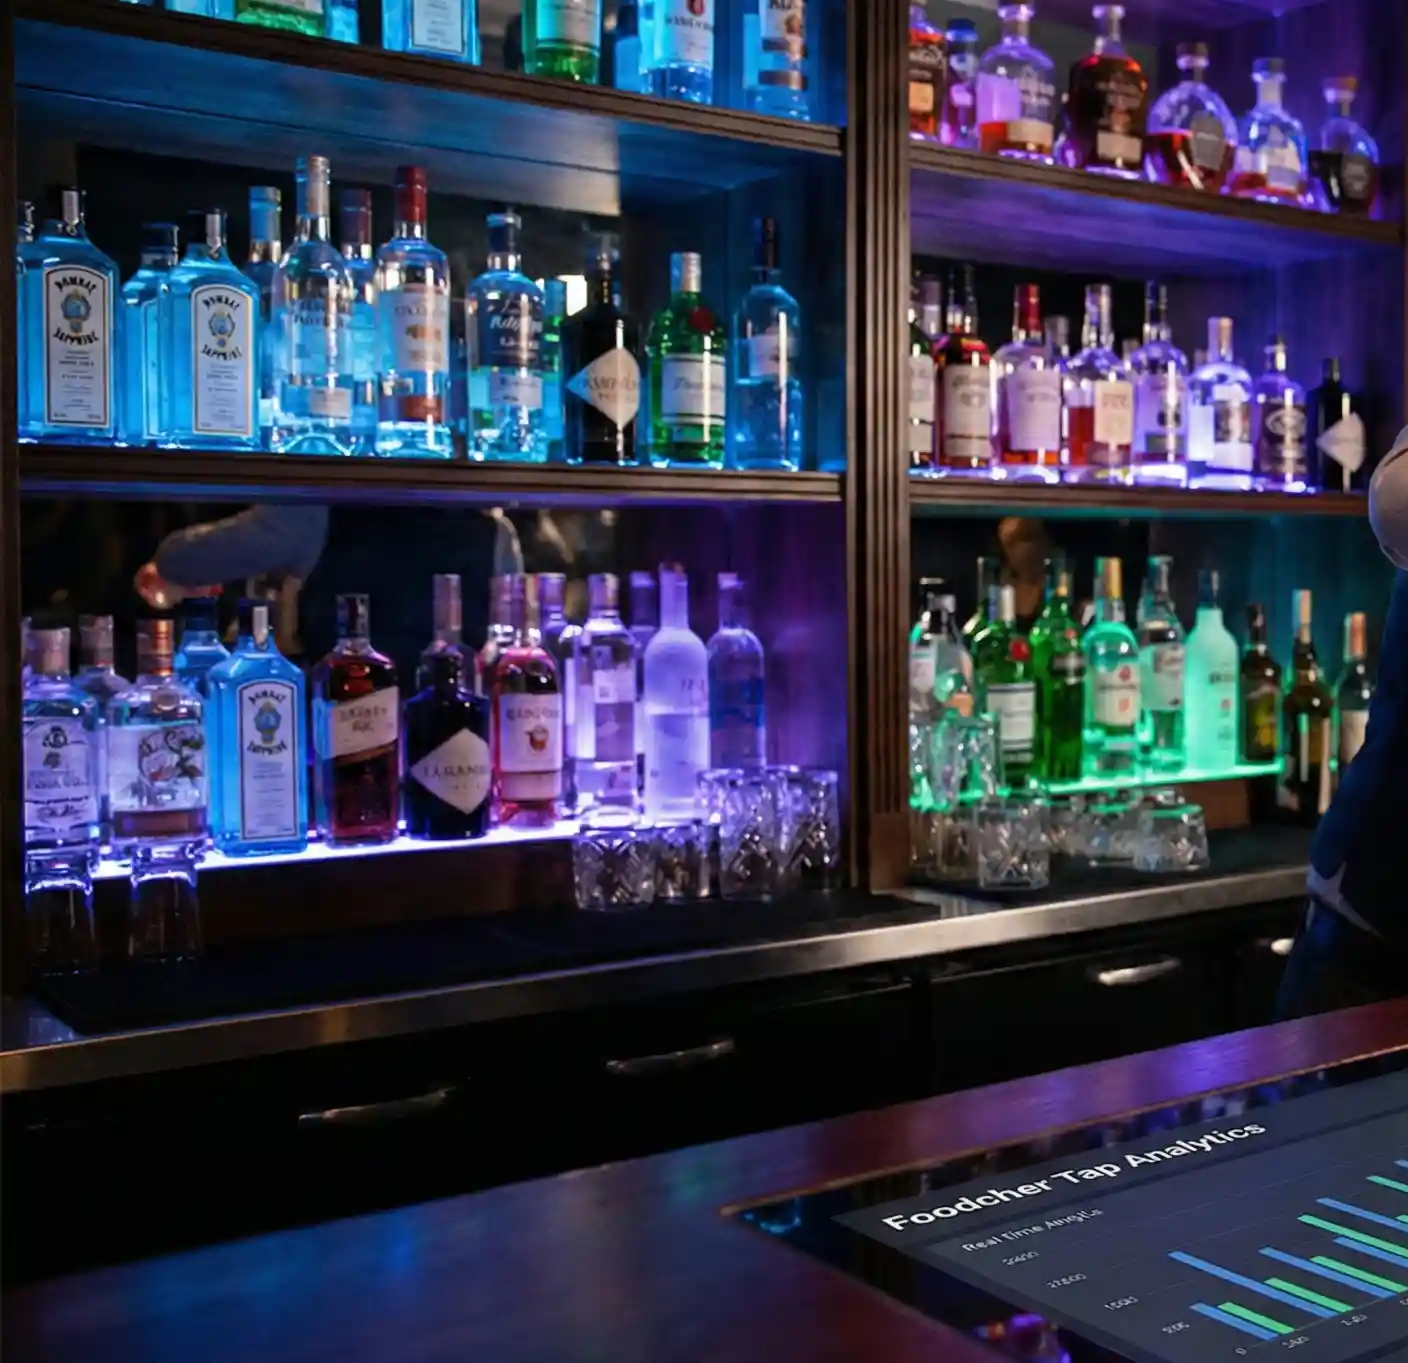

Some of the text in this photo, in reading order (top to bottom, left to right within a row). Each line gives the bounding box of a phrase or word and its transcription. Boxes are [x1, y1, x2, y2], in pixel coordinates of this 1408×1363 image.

[881, 1120, 1268, 1232] Foodcher Tap Analytics
